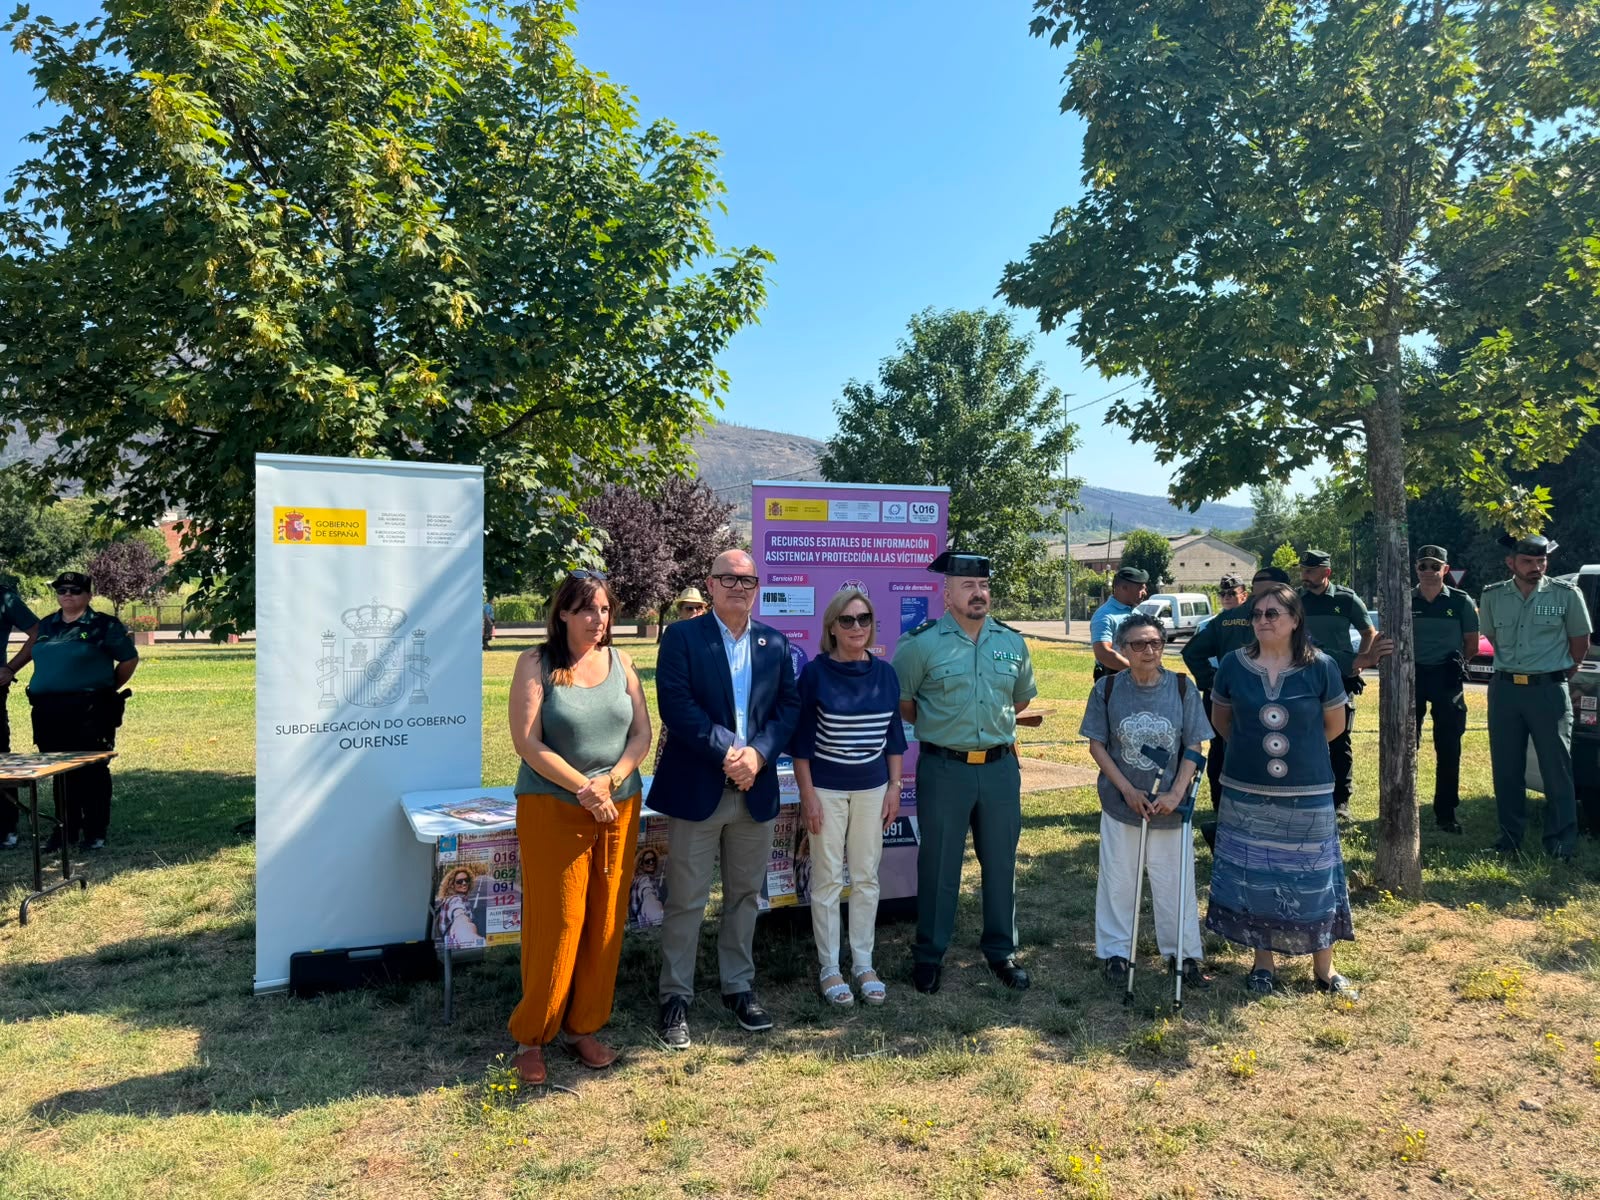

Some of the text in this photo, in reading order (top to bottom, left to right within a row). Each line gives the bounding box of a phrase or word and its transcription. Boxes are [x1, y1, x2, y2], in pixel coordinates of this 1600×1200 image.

[918, 504, 935, 514] 016
[315, 520, 360, 529] GOBIERNO
[328, 530, 360, 538] ESPAÑA
[771, 536, 930, 549] RECURSOS ESTATALES DE INFORMACIÓN
[765, 550, 935, 563] ASISTENCIA Y PROTECCIÓN A LAS VÍCTIMAS
[275, 715, 467, 736] SUBDELEGACIÓN DO GOBERNO
[338, 733, 409, 750] OURENSE
[773, 822, 792, 833] 016
[883, 821, 903, 837] 091
[772, 838, 791, 848] 062
[493, 851, 517, 863] 016
[771, 849, 789, 860] 091
[772, 861, 789, 871] 112
[493, 868, 517, 880] 062
[492, 882, 515, 893] 091
[494, 894, 516, 906] 112
